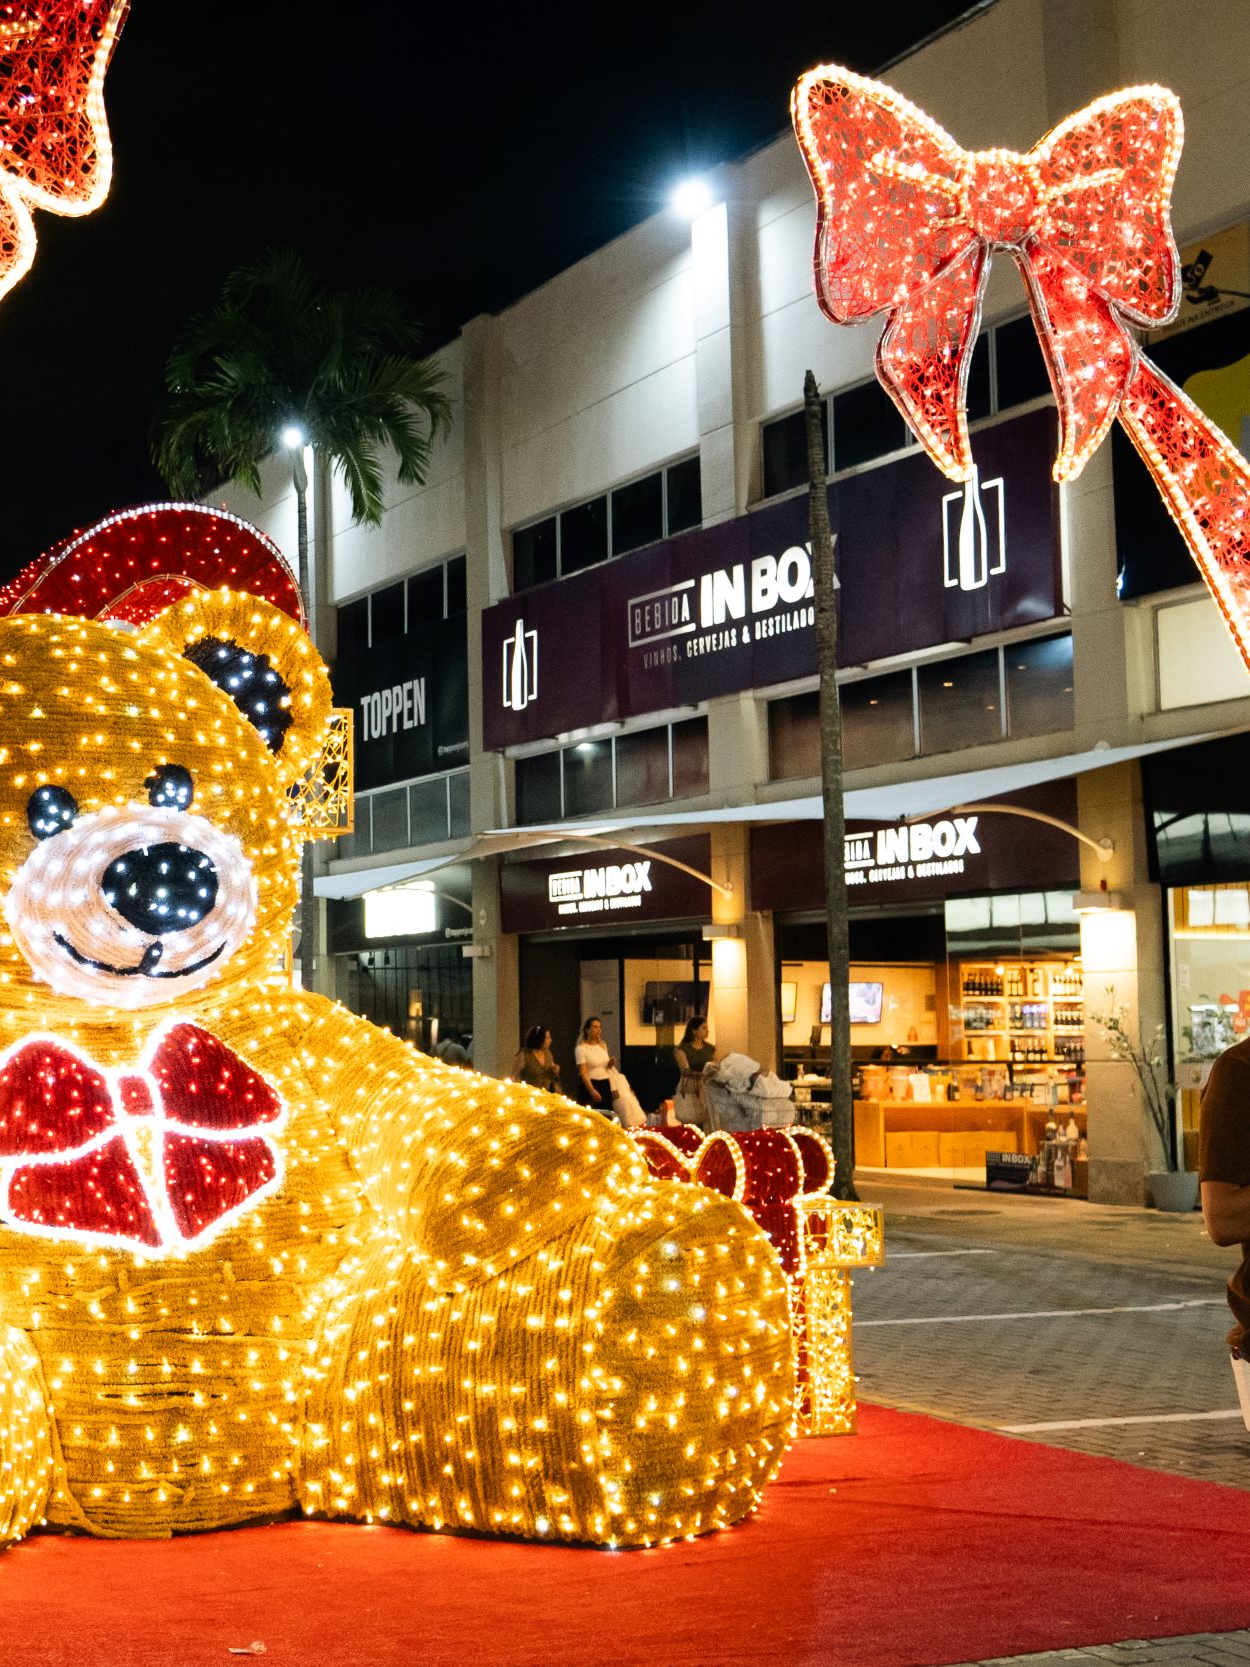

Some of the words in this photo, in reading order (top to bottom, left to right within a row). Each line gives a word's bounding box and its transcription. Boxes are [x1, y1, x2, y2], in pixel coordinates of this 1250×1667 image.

[635, 593, 690, 636] BEBIDA
[686, 628, 737, 658] CERVEJAS
[742, 625, 751, 644] &
[755, 606, 815, 641] DESTILADO
[360, 677, 426, 742] TOPPEN
